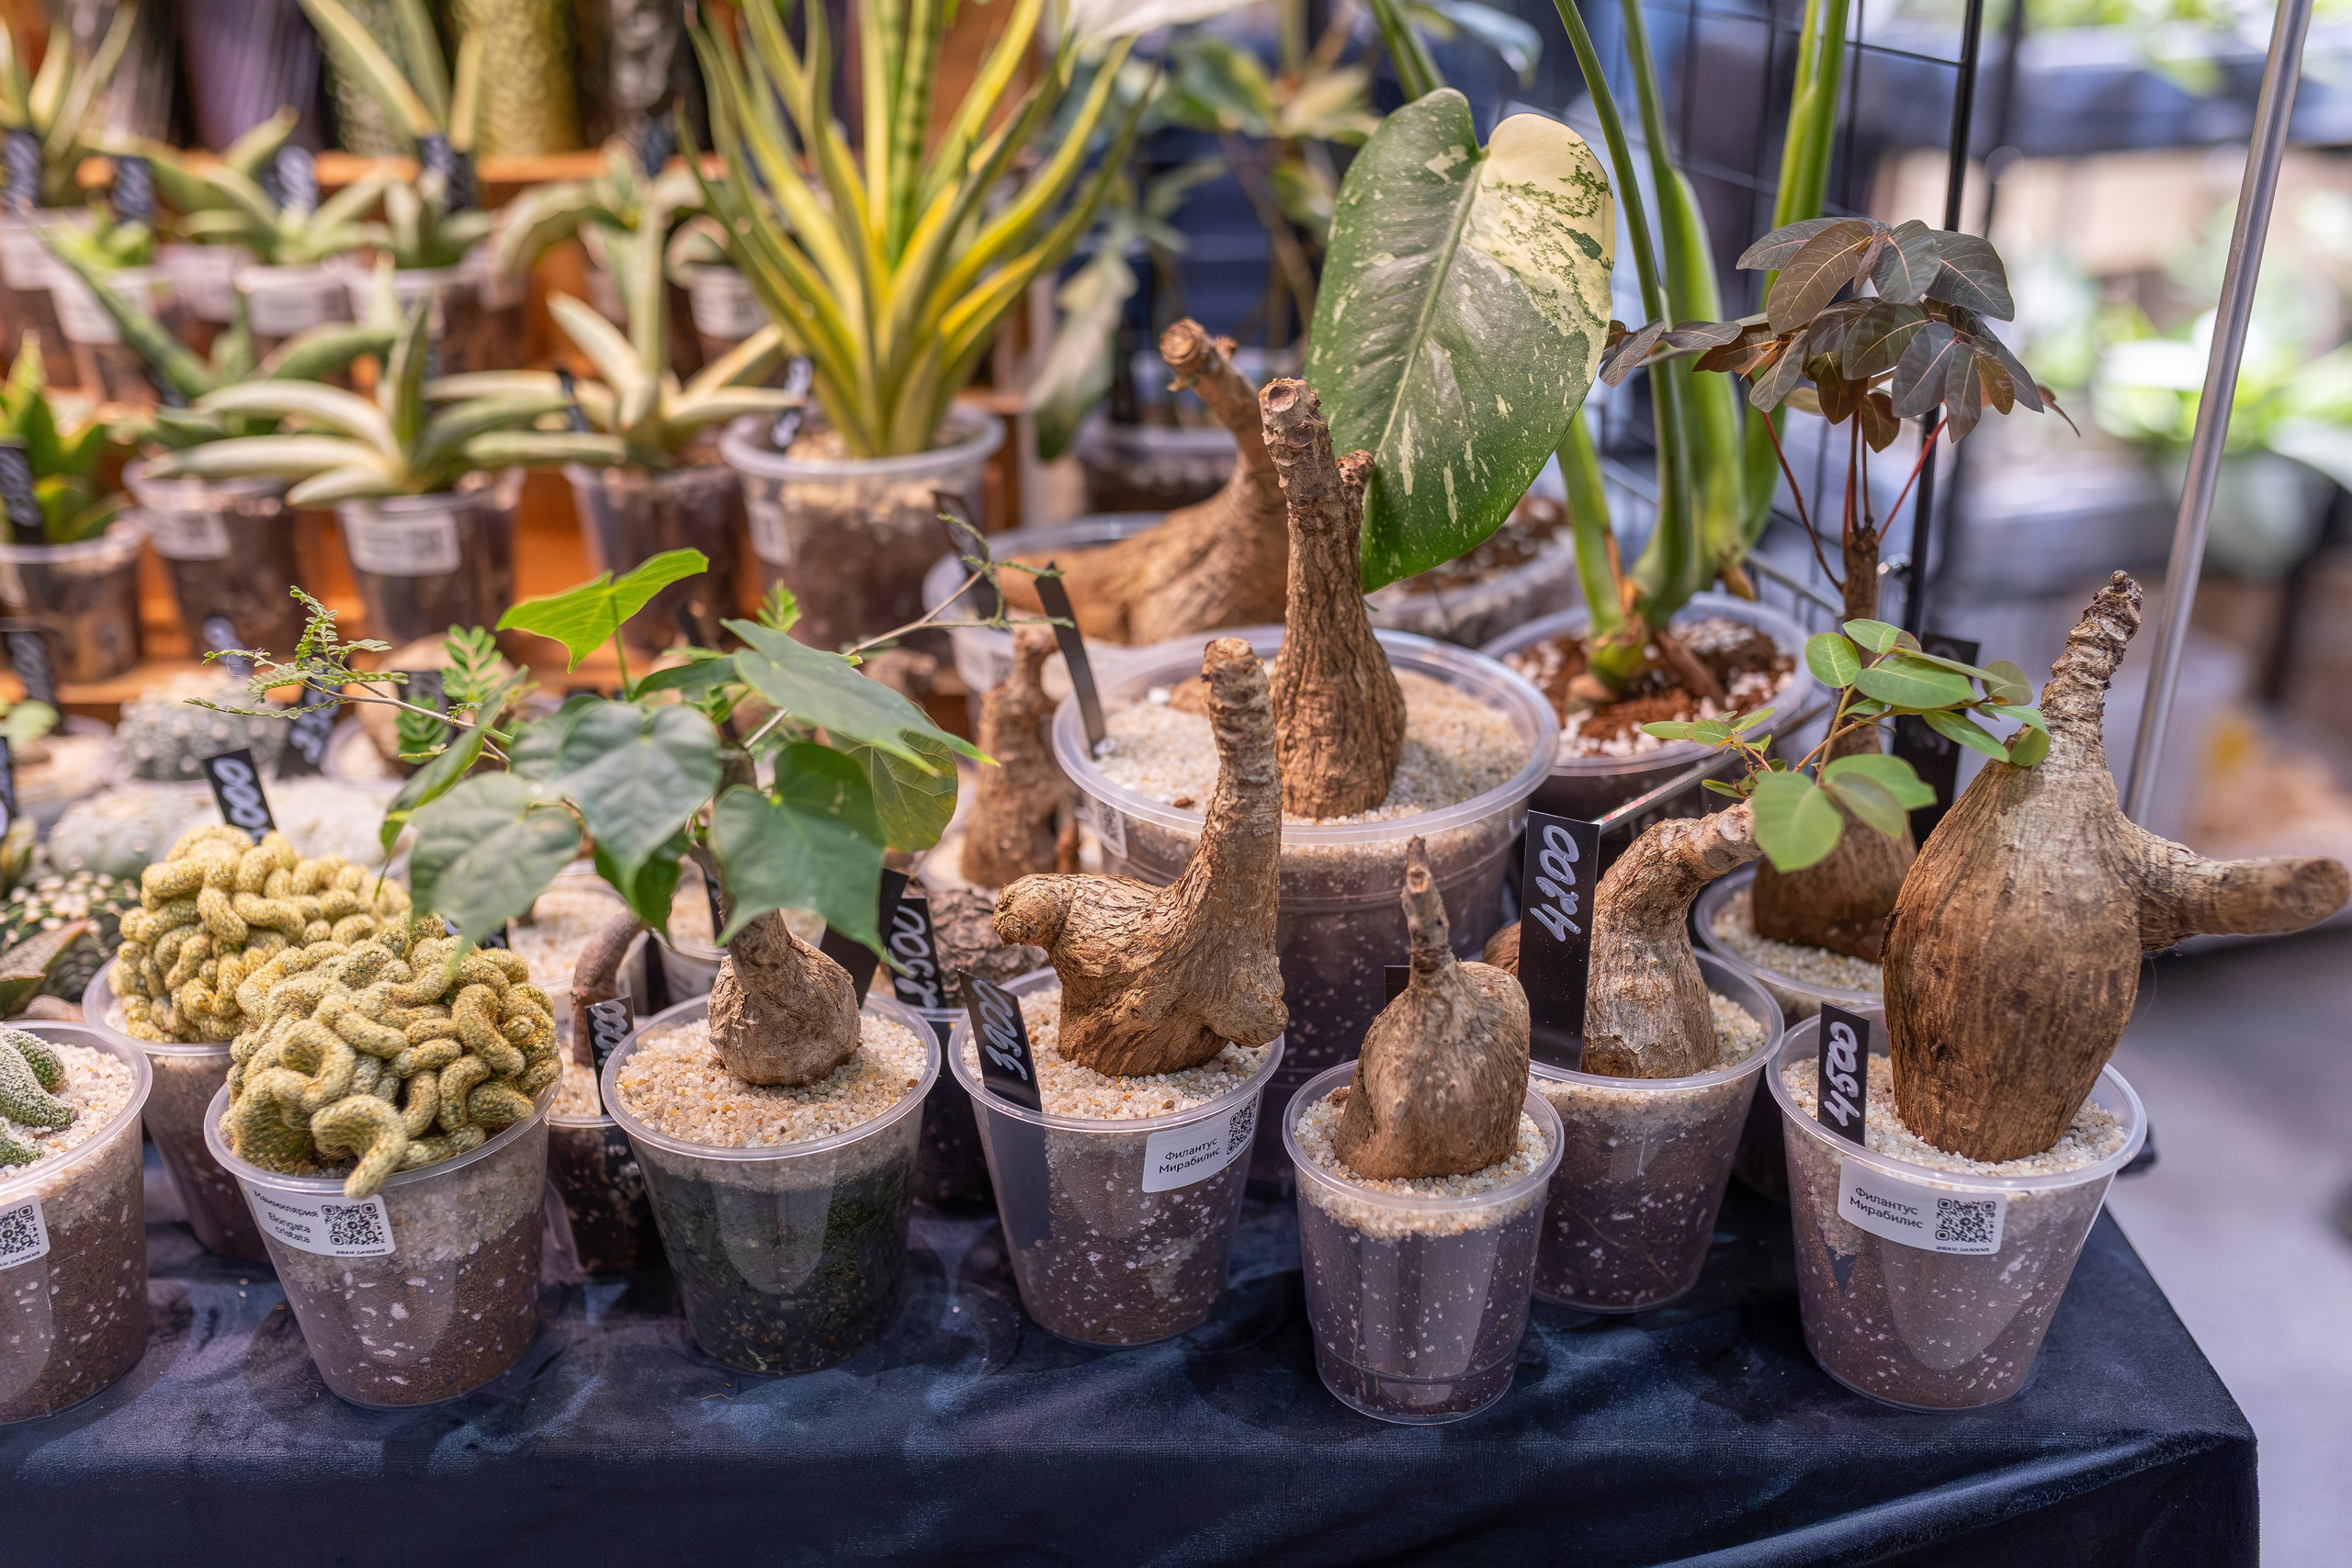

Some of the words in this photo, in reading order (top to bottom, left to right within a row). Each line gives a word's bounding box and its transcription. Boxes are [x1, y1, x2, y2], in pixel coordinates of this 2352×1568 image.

[1529, 824, 1581, 942] 4200
[888, 905, 939, 1009] 2500
[590, 999, 629, 1066] 000
[970, 978, 1028, 1081] 3900
[1823, 1021, 1860, 1127] 4500
[1159, 1147, 1220, 1174] Мирабилис
[1164, 1137, 1217, 1160] Филантус
[253, 1189, 319, 1218] Маммилярия
[1849, 1195, 1924, 1229] Мирабилис
[1855, 1187, 1919, 1216] Филантус
[267, 1211, 311, 1234] Elongata
[275, 1225, 311, 1244] cristata
